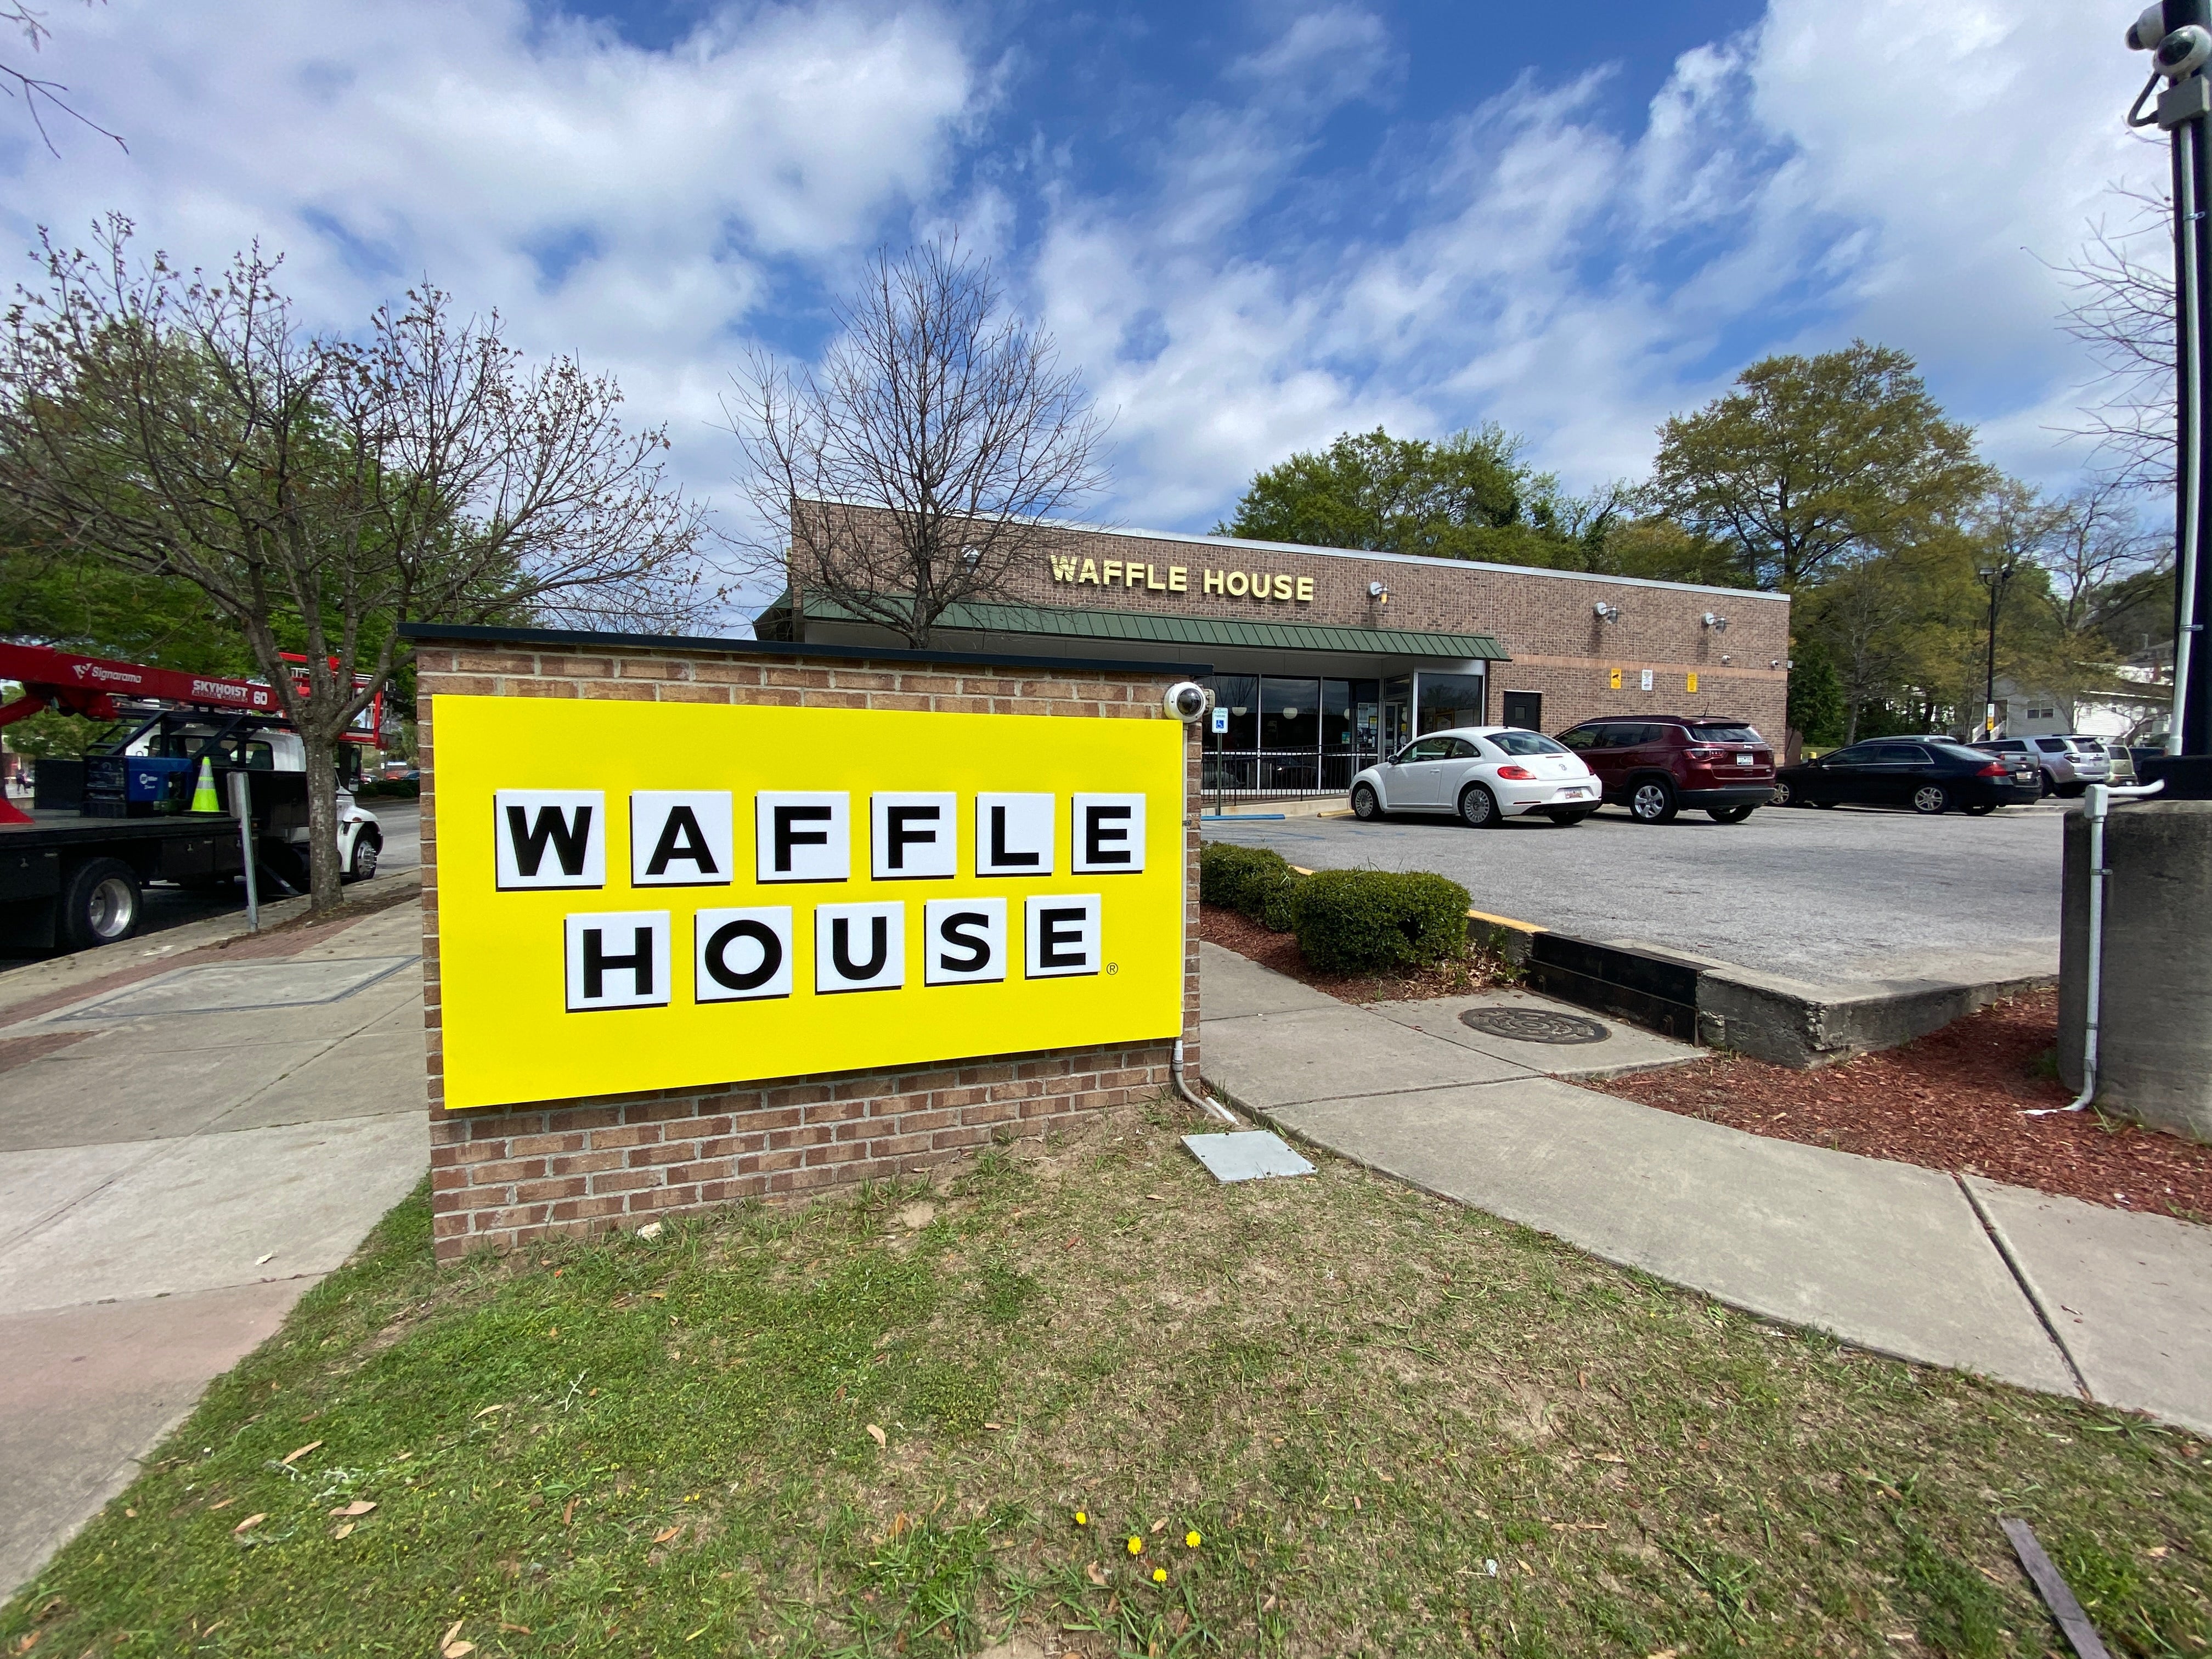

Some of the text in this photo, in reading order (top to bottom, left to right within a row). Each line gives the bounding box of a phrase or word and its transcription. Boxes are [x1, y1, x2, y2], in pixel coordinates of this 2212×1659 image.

[1051, 555, 1314, 601] WAFFLE HOUSE
[92, 666, 142, 684] Signarama
[193, 680, 268, 705] SKYHOIST 60
[506, 806, 1131, 877] WAFFLE
[583, 907, 1086, 998] HOUSE
